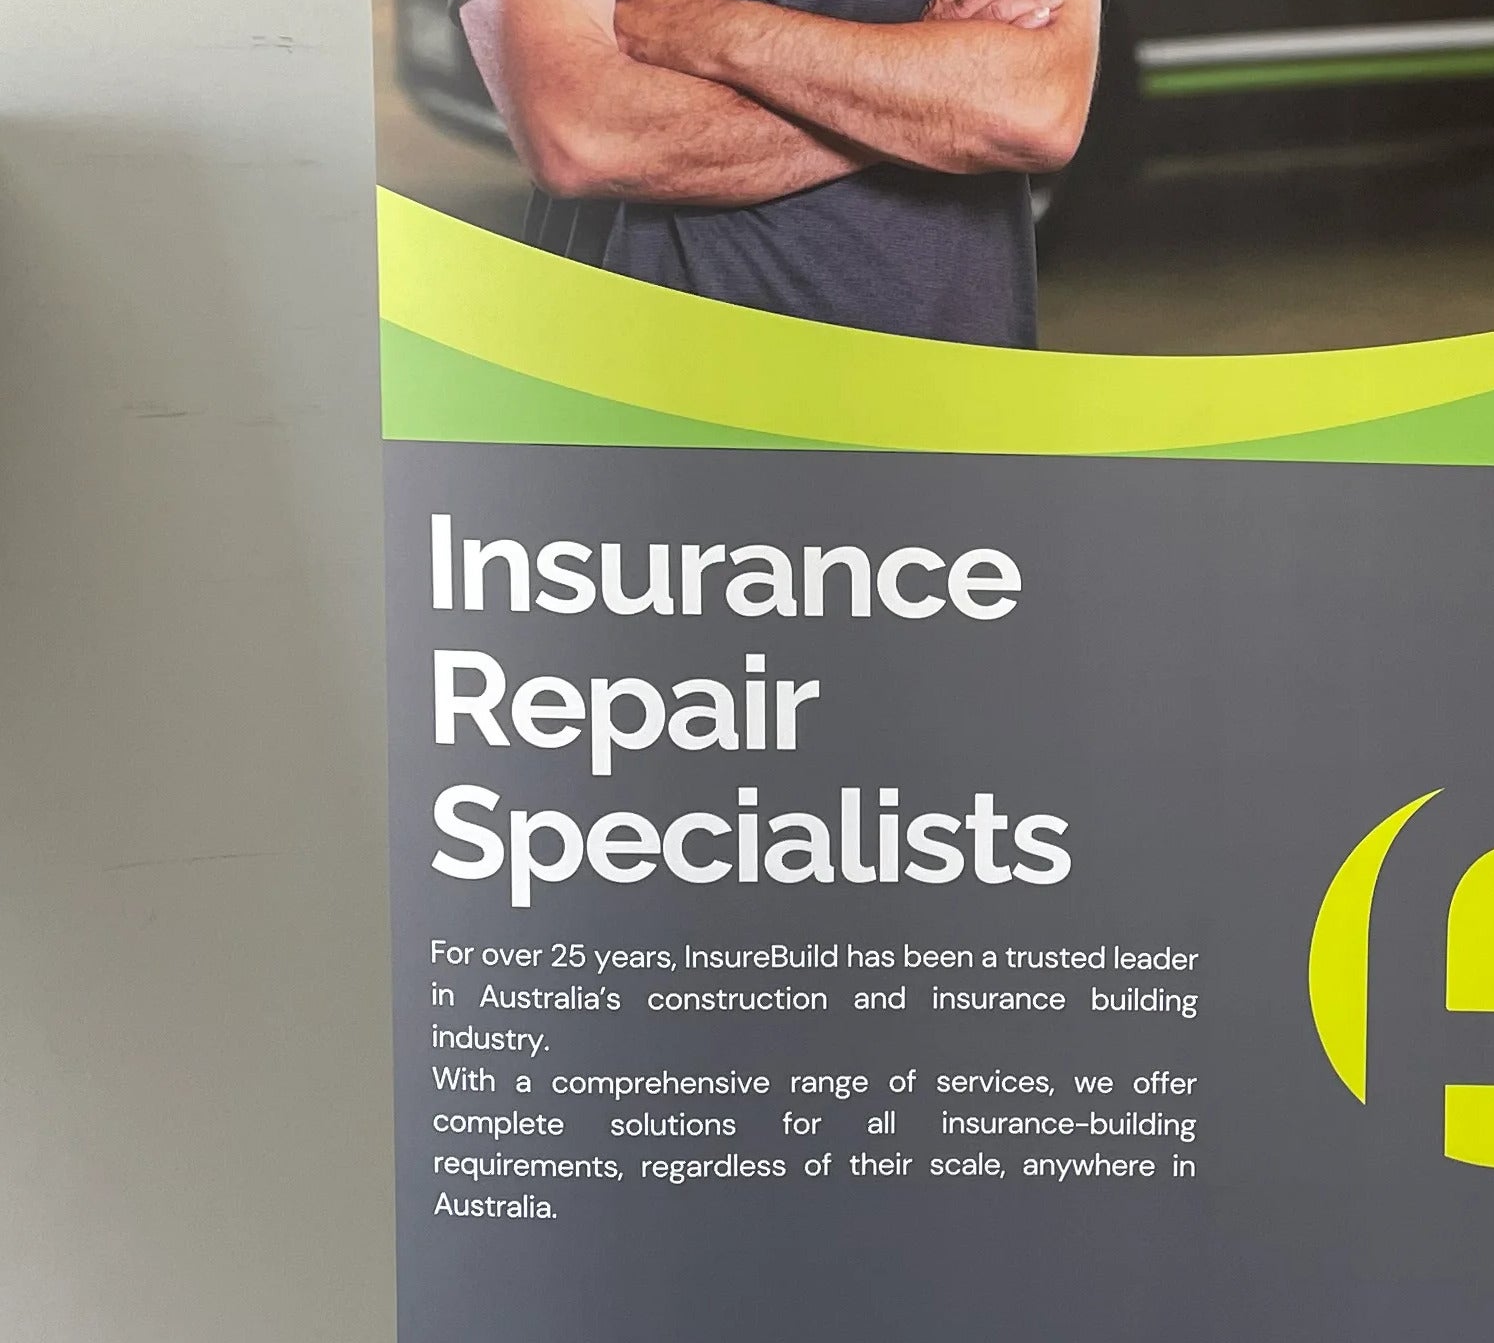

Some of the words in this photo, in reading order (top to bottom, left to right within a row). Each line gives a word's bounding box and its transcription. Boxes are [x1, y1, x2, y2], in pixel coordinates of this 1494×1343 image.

[430, 512, 1023, 621] Insurance
[432, 648, 821, 776] Repair
[431, 784, 1074, 908] Specialists
[432, 940, 474, 965] For
[482, 948, 542, 966] over
[552, 944, 585, 967] 25
[594, 951, 676, 974] years,
[686, 944, 837, 968] InsureBuild
[848, 944, 894, 967] has
[905, 944, 972, 967] been
[982, 951, 996, 967] a
[1006, 946, 1105, 968] trusted
[1115, 946, 1198, 970] leader
[432, 982, 454, 1005] in
[480, 985, 620, 1011] Australia's
[648, 987, 826, 1010] construction
[855, 986, 905, 1009] and
[934, 986, 1065, 1010] insurance
[1092, 987, 1198, 1018] building
[433, 1024, 549, 1057] industry.
[432, 1067, 495, 1091] With
[516, 1076, 531, 1092] a
[552, 1071, 769, 1100] comprehensive
[792, 1076, 868, 1099] range
[890, 1069, 916, 1092] of
[937, 1070, 1054, 1096] services,
[1075, 1077, 1113, 1093] we
[1134, 1071, 1197, 1094] offer
[434, 1111, 563, 1140] complete
[611, 1113, 735, 1136] solutions
[783, 1112, 821, 1134] for
[868, 1111, 895, 1134] all
[943, 1111, 1196, 1142] insurance-building
[435, 1152, 623, 1181] requirements,
[642, 1154, 786, 1184] regardless
[805, 1153, 831, 1176] of
[850, 1152, 912, 1175] their
[931, 1152, 1005, 1178] scale,
[1024, 1153, 1155, 1182] anywhere
[1174, 1154, 1195, 1176] in
[434, 1192, 556, 1218] Australia.
